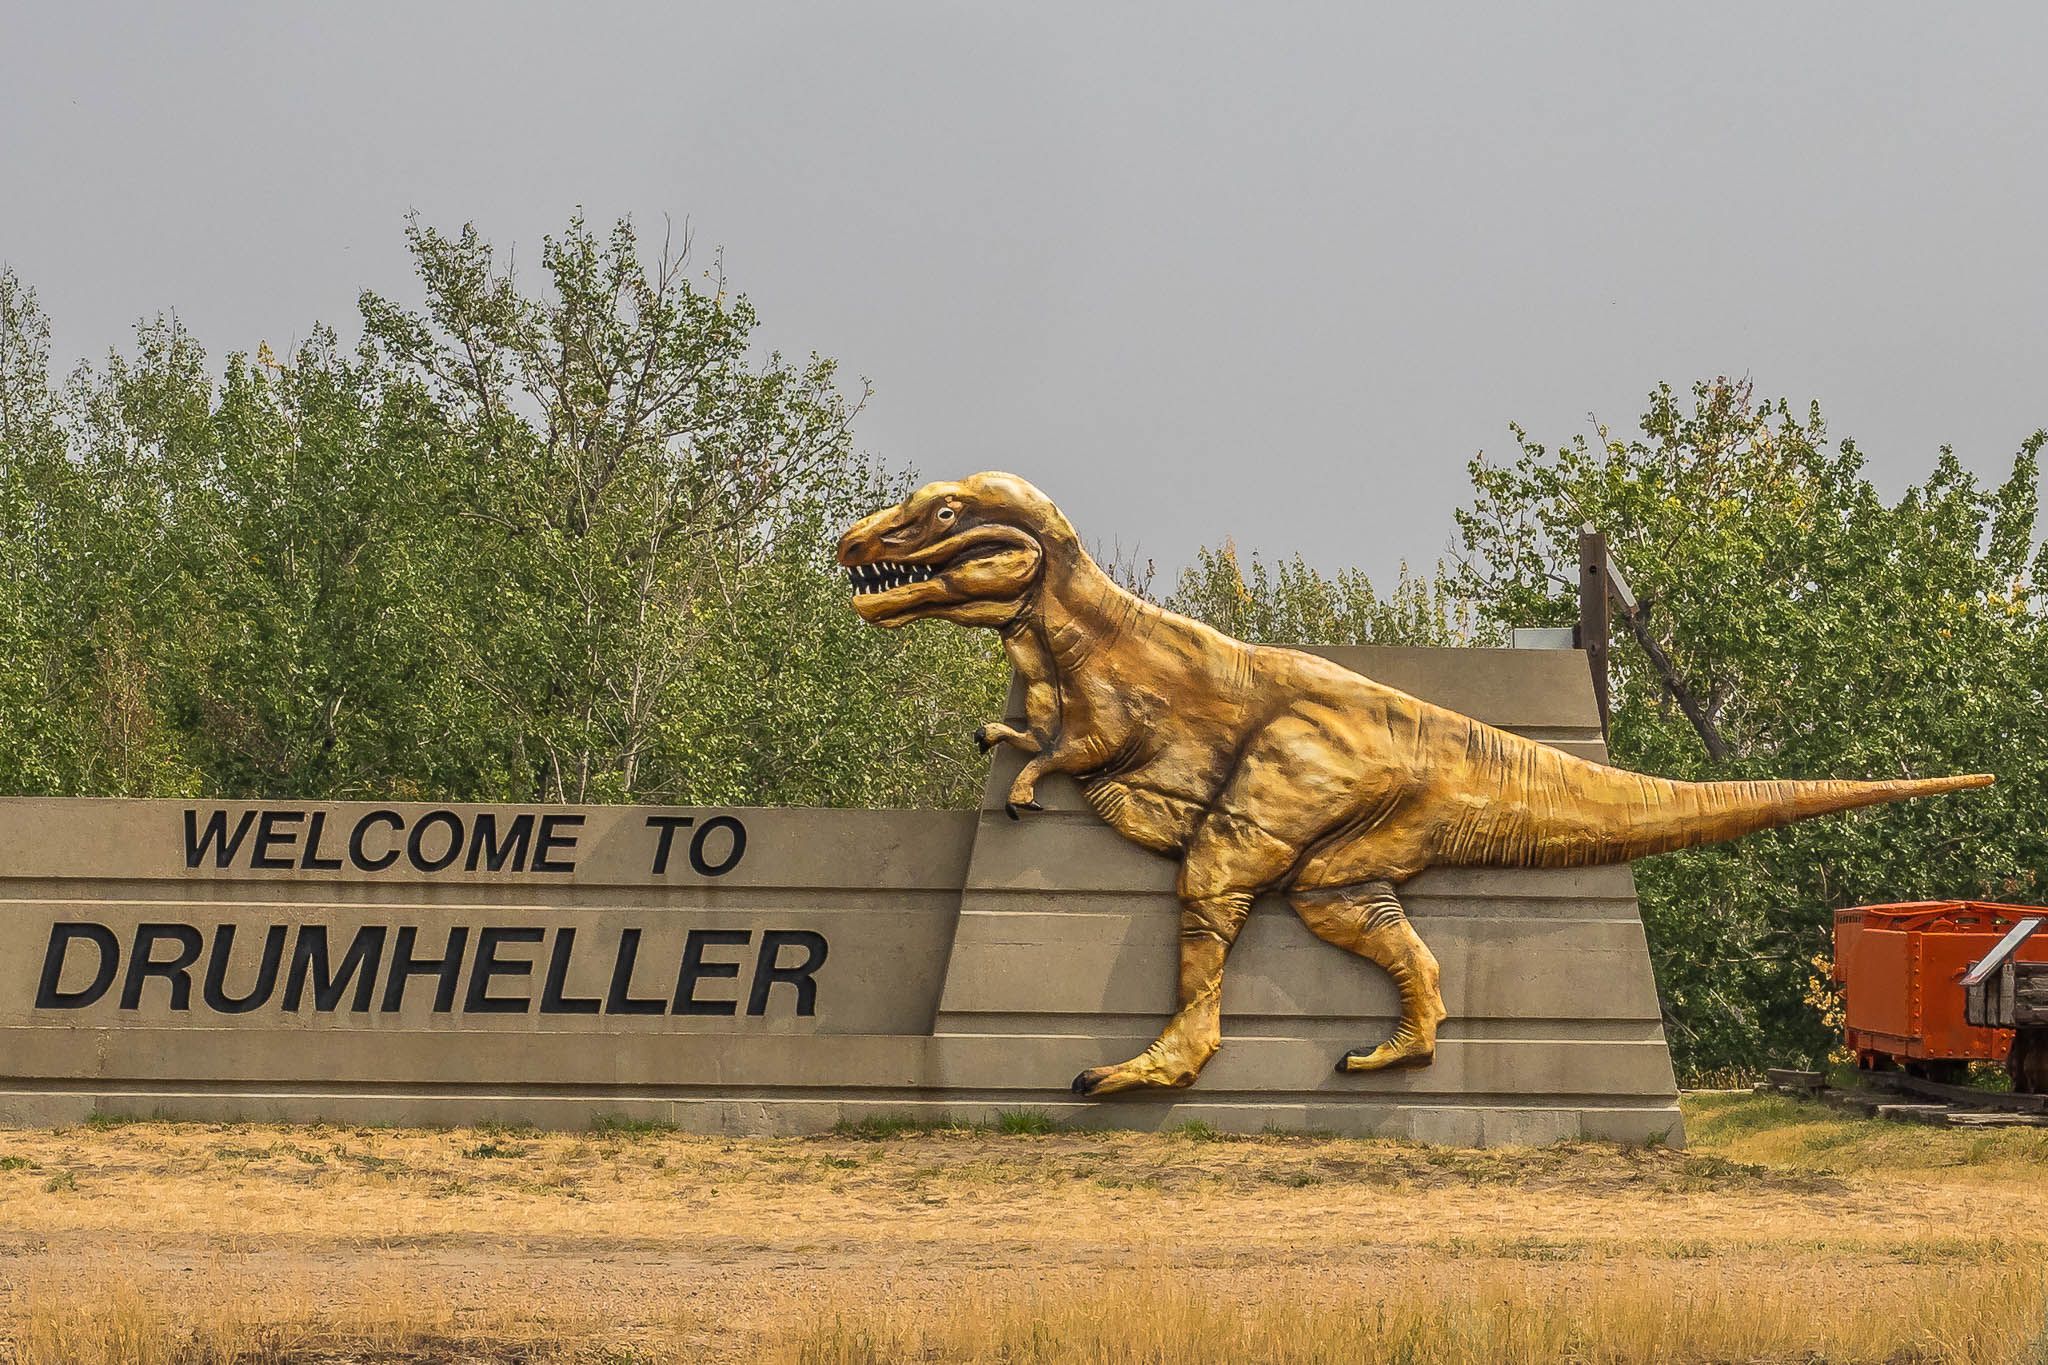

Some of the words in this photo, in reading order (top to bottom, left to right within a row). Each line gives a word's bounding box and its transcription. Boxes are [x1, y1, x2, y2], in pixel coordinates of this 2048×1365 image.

[184, 809, 587, 873] WELCOME
[646, 815, 747, 877] TO
[35, 922, 829, 1017] DRUMHELLER
